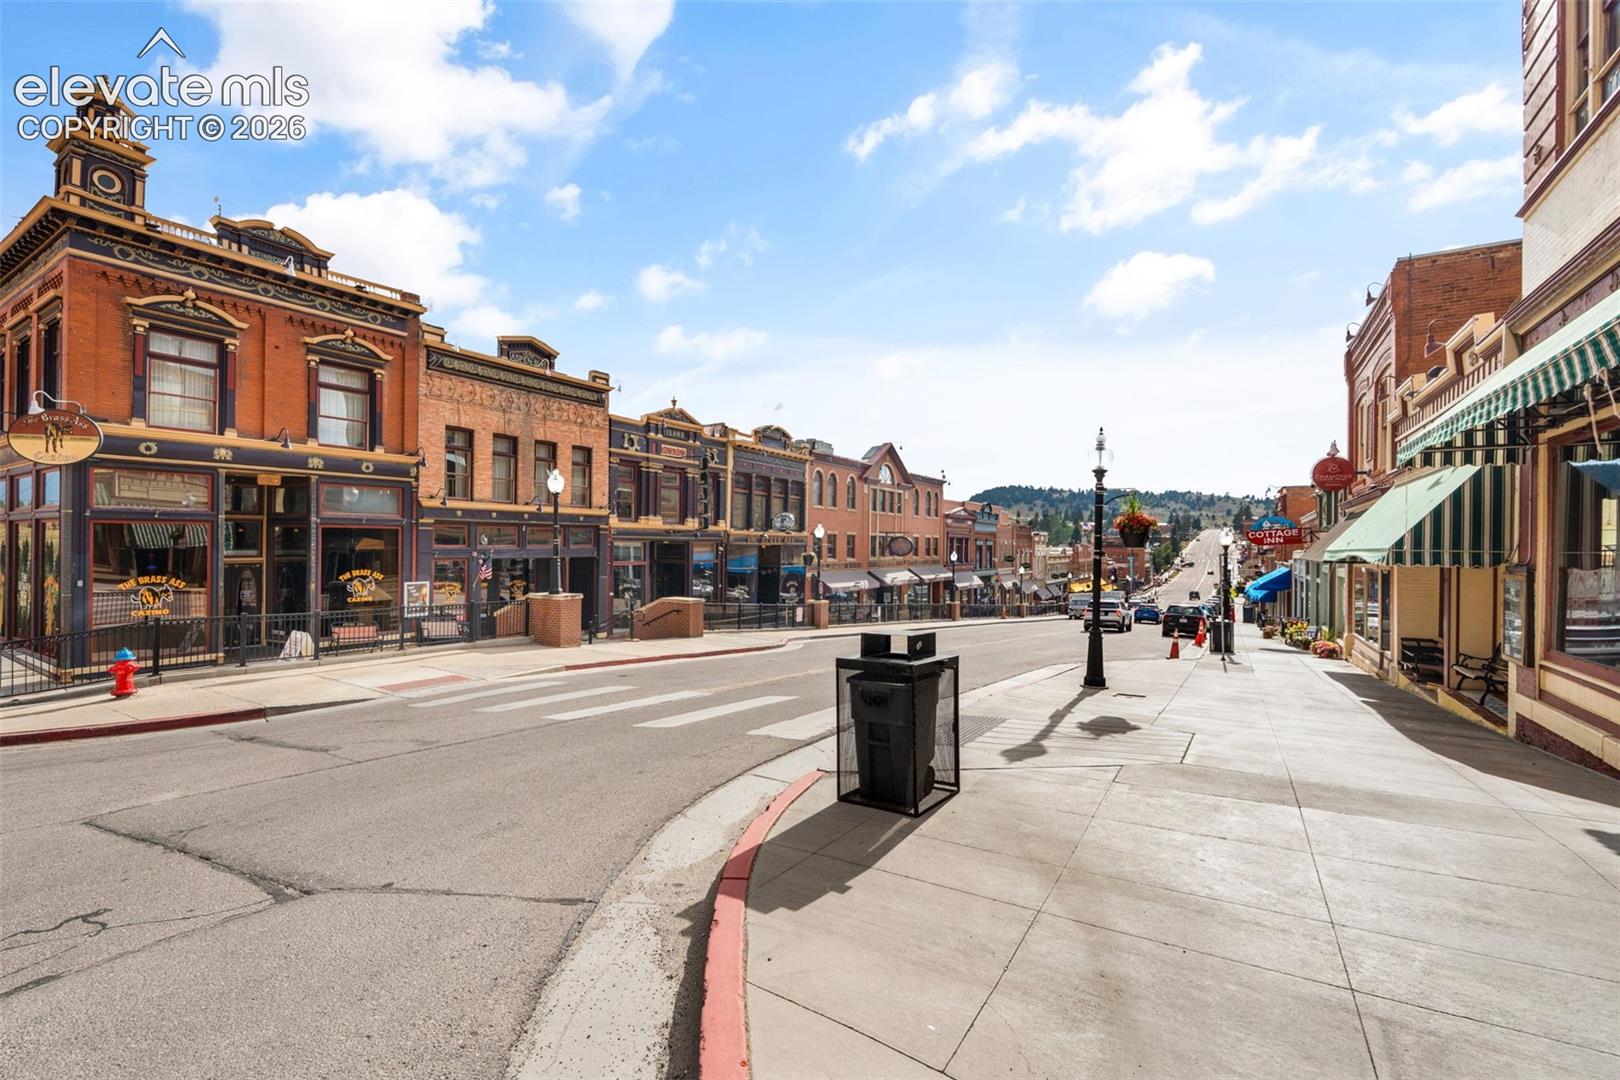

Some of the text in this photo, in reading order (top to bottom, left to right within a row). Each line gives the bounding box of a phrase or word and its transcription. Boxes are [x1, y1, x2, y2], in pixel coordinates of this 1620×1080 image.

[1248, 528, 1299, 539] COTTAGE
[338, 572, 351, 581] THE
[372, 571, 384, 580] ASS
[117, 575, 187, 591] THE BRASS ASS
[131, 608, 170, 616] CASINO
